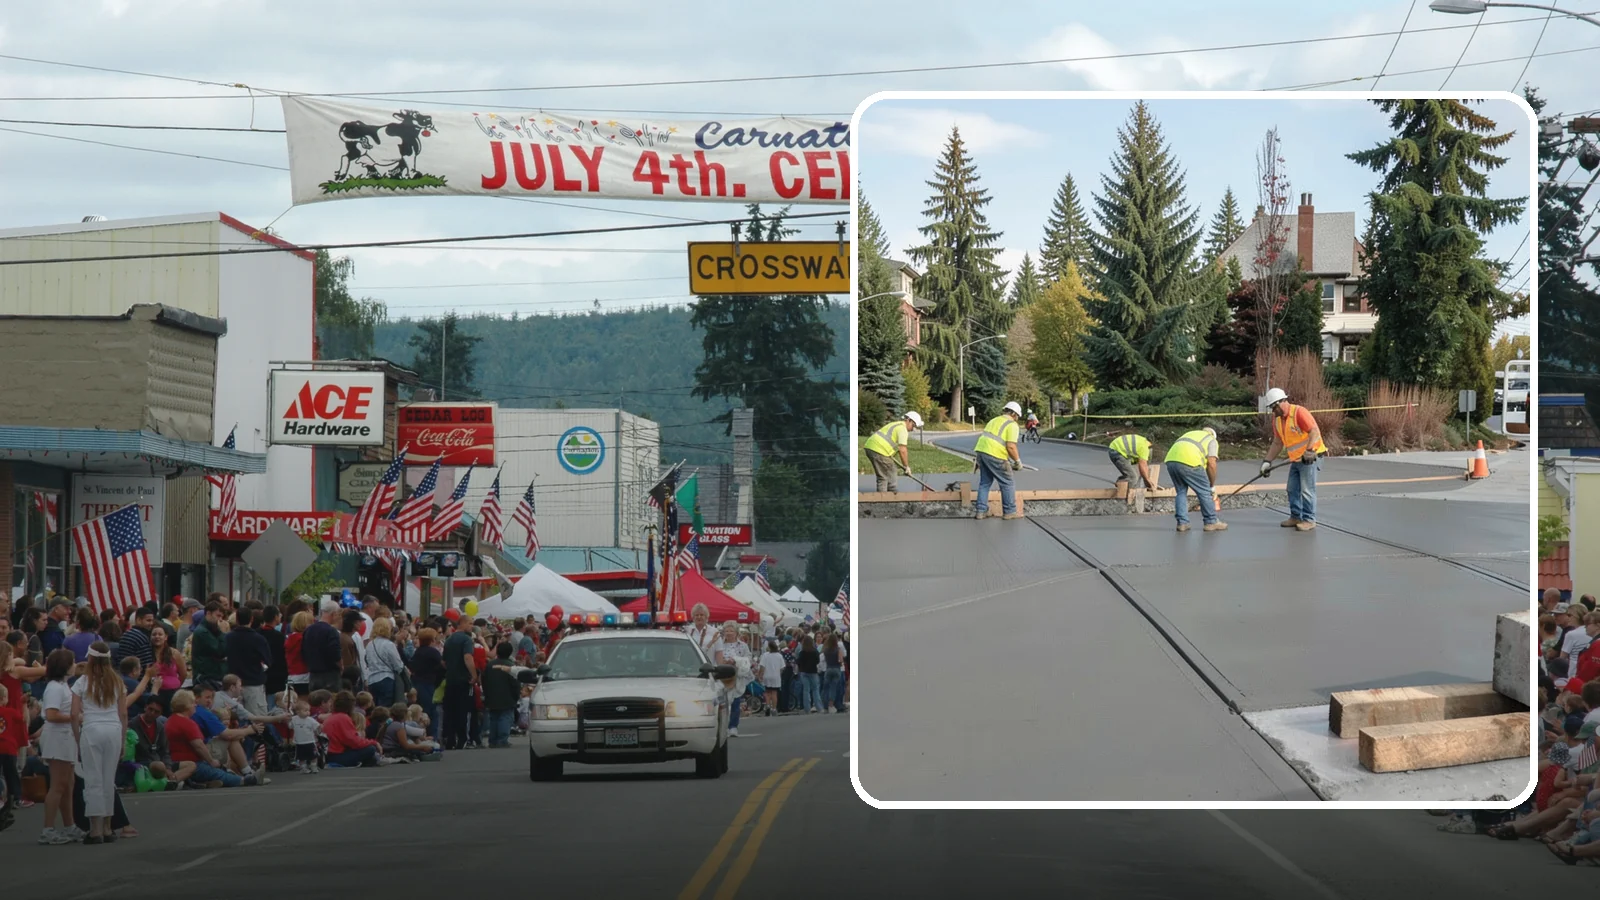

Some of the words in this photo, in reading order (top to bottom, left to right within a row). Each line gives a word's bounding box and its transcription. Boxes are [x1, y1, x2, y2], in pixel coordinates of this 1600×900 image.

[481, 141, 605, 192] JULY
[632, 150, 746, 198] 4th.
[696, 254, 850, 280] CROSSWA
[283, 380, 373, 420] ACE
[406, 409, 452, 422] CEDAR
[461, 409, 485, 422] LOG
[283, 421, 371, 437] Hardware
[416, 428, 477, 447] Coca-Cola
[353, 467, 385, 481] Simpl
[96, 485, 124, 495] Vincent
[126, 485, 136, 495] de
[138, 485, 155, 495] Paul
[81, 503, 154, 522] THT
[212, 516, 331, 535] HARDARE
[688, 526, 741, 535] CRNATION
[699, 535, 730, 543] GLASS
